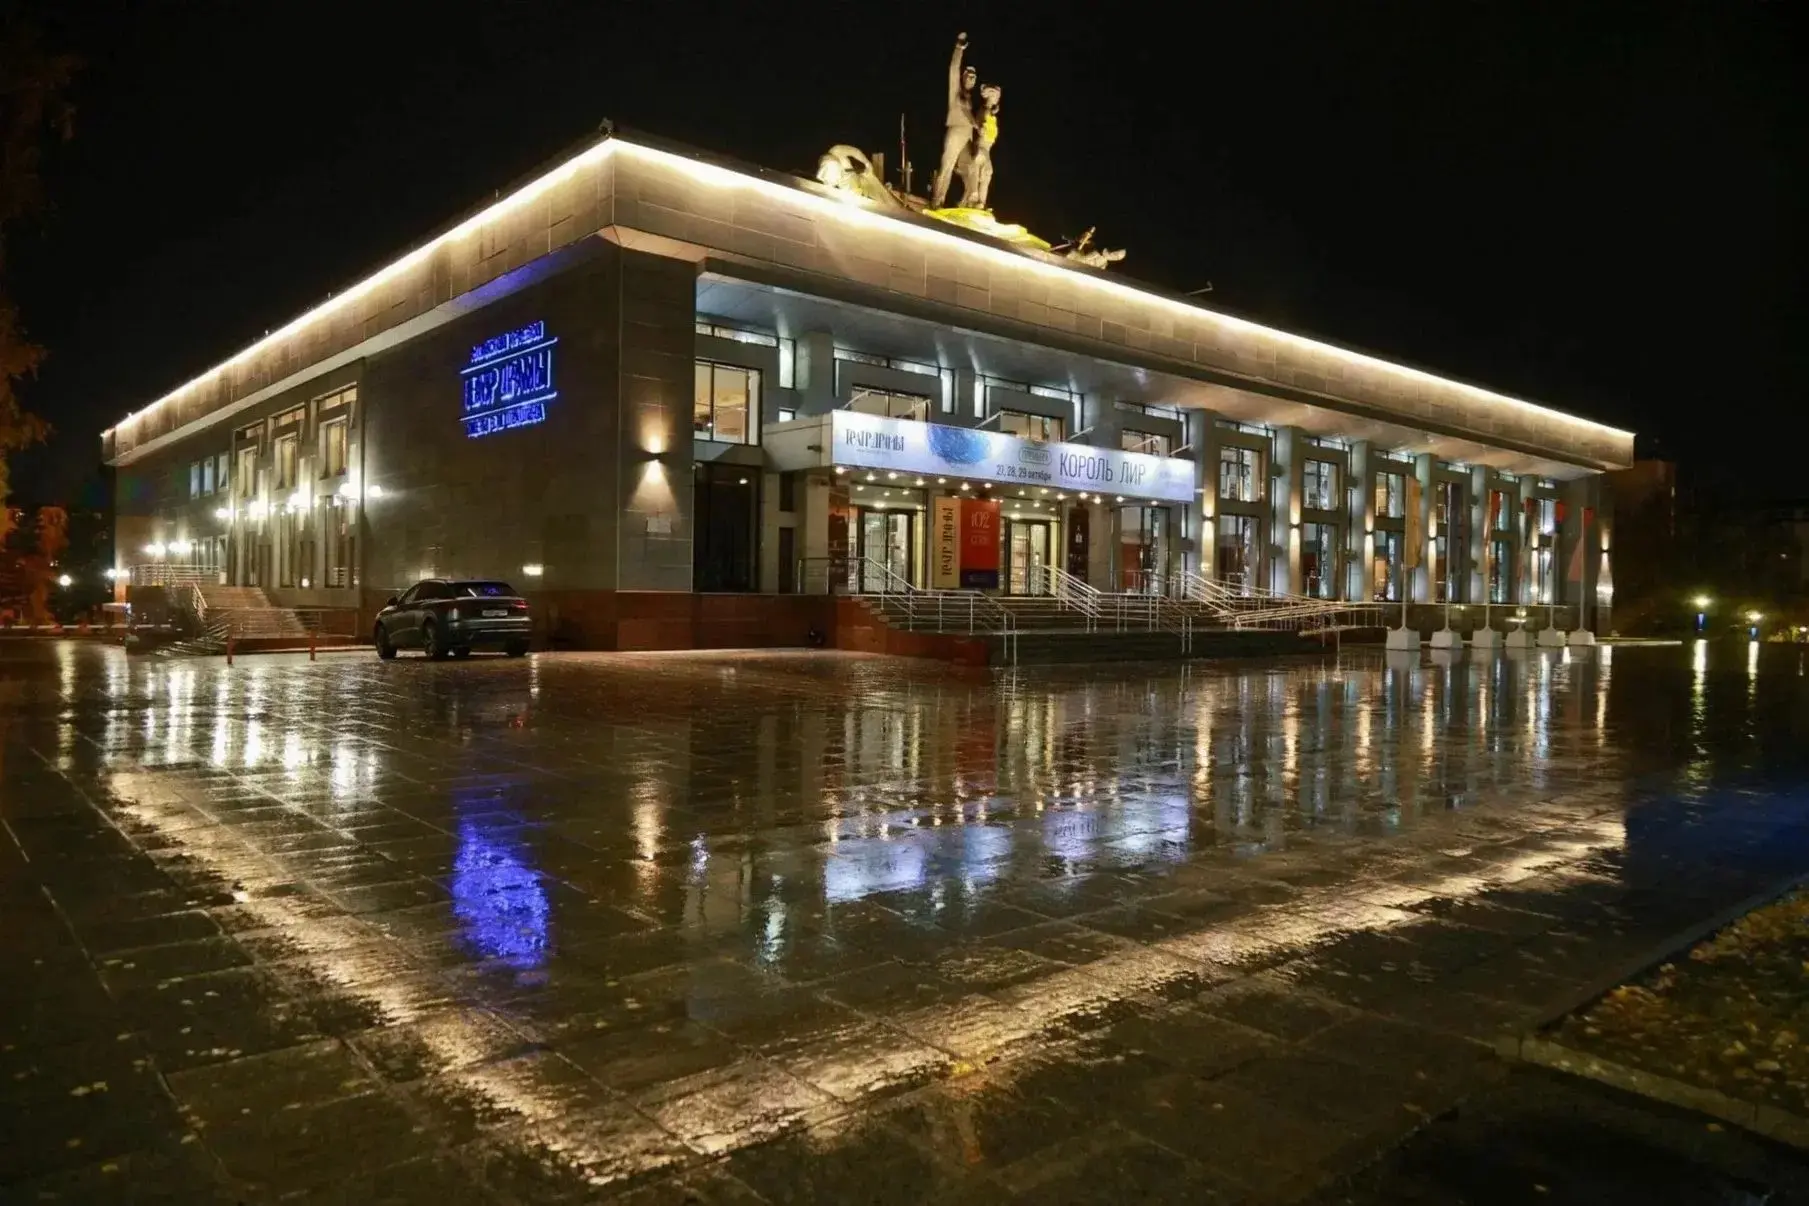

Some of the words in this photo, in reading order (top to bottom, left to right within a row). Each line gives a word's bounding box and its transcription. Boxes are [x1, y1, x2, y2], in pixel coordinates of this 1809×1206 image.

[1018, 466, 1027, 480] 29
[1028, 470, 1052, 484] октября
[1059, 452, 1114, 482] КОРОЛЬ
[1119, 461, 1146, 486] ЛИР
